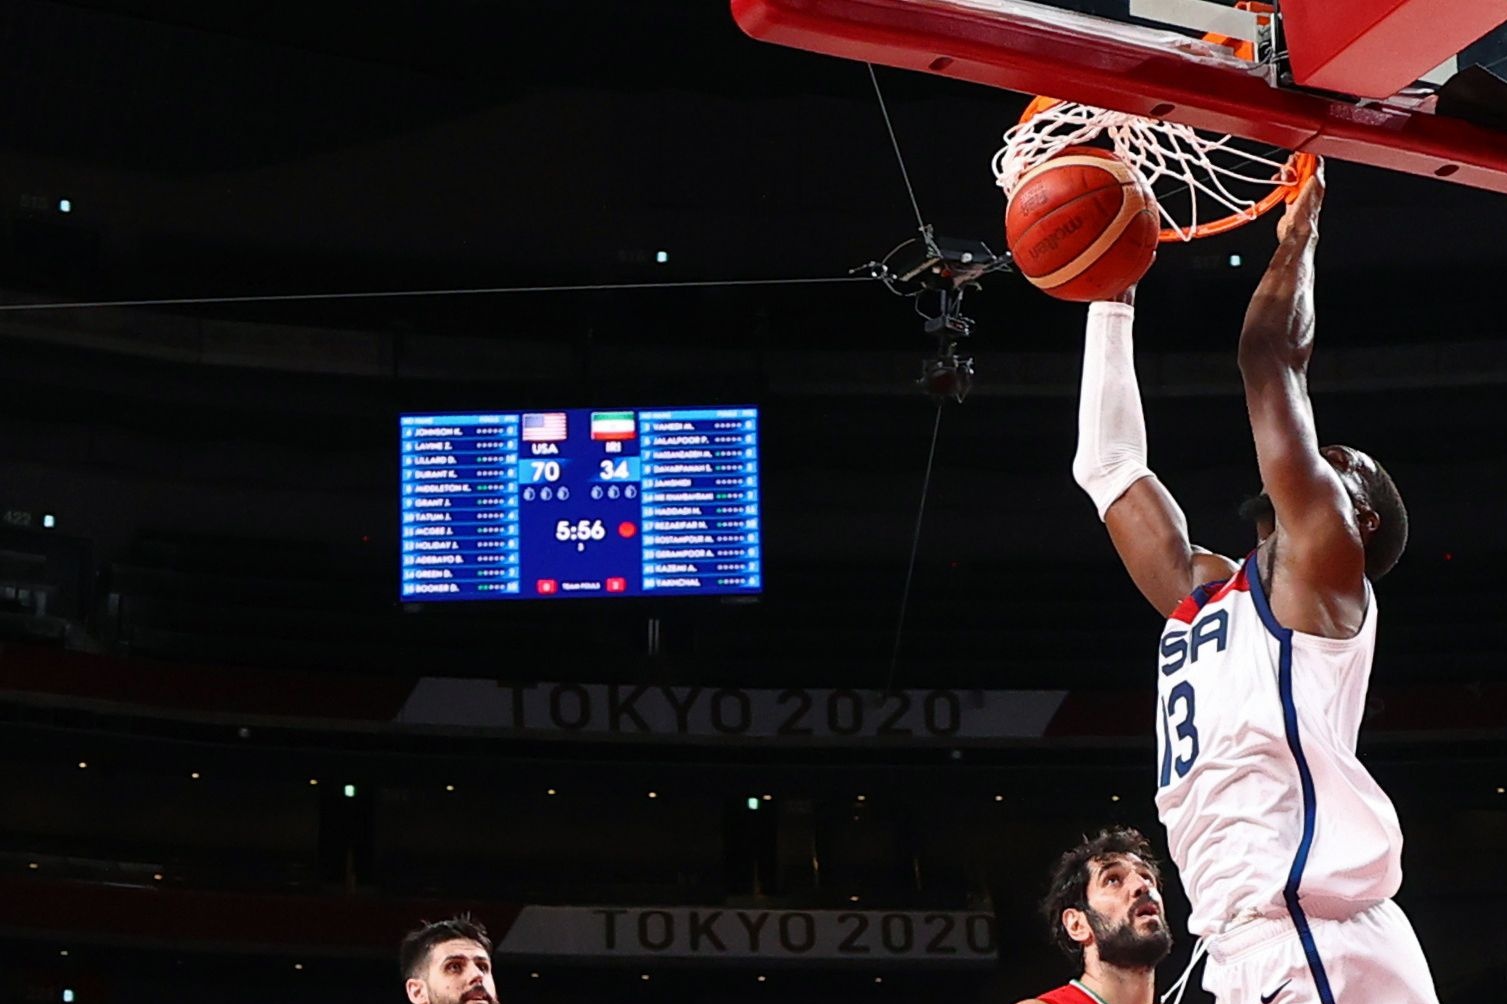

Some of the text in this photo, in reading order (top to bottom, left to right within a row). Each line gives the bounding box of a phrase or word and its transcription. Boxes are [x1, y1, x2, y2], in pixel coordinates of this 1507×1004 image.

[531, 443, 559, 455] USA
[531, 461, 560, 482] 70
[600, 459, 630, 480] 34
[555, 519, 606, 541] 5:56
[1160, 607, 1229, 677] SA
[496, 678, 961, 736] TOKYO 2020
[593, 910, 998, 955] TOKYO 2020
